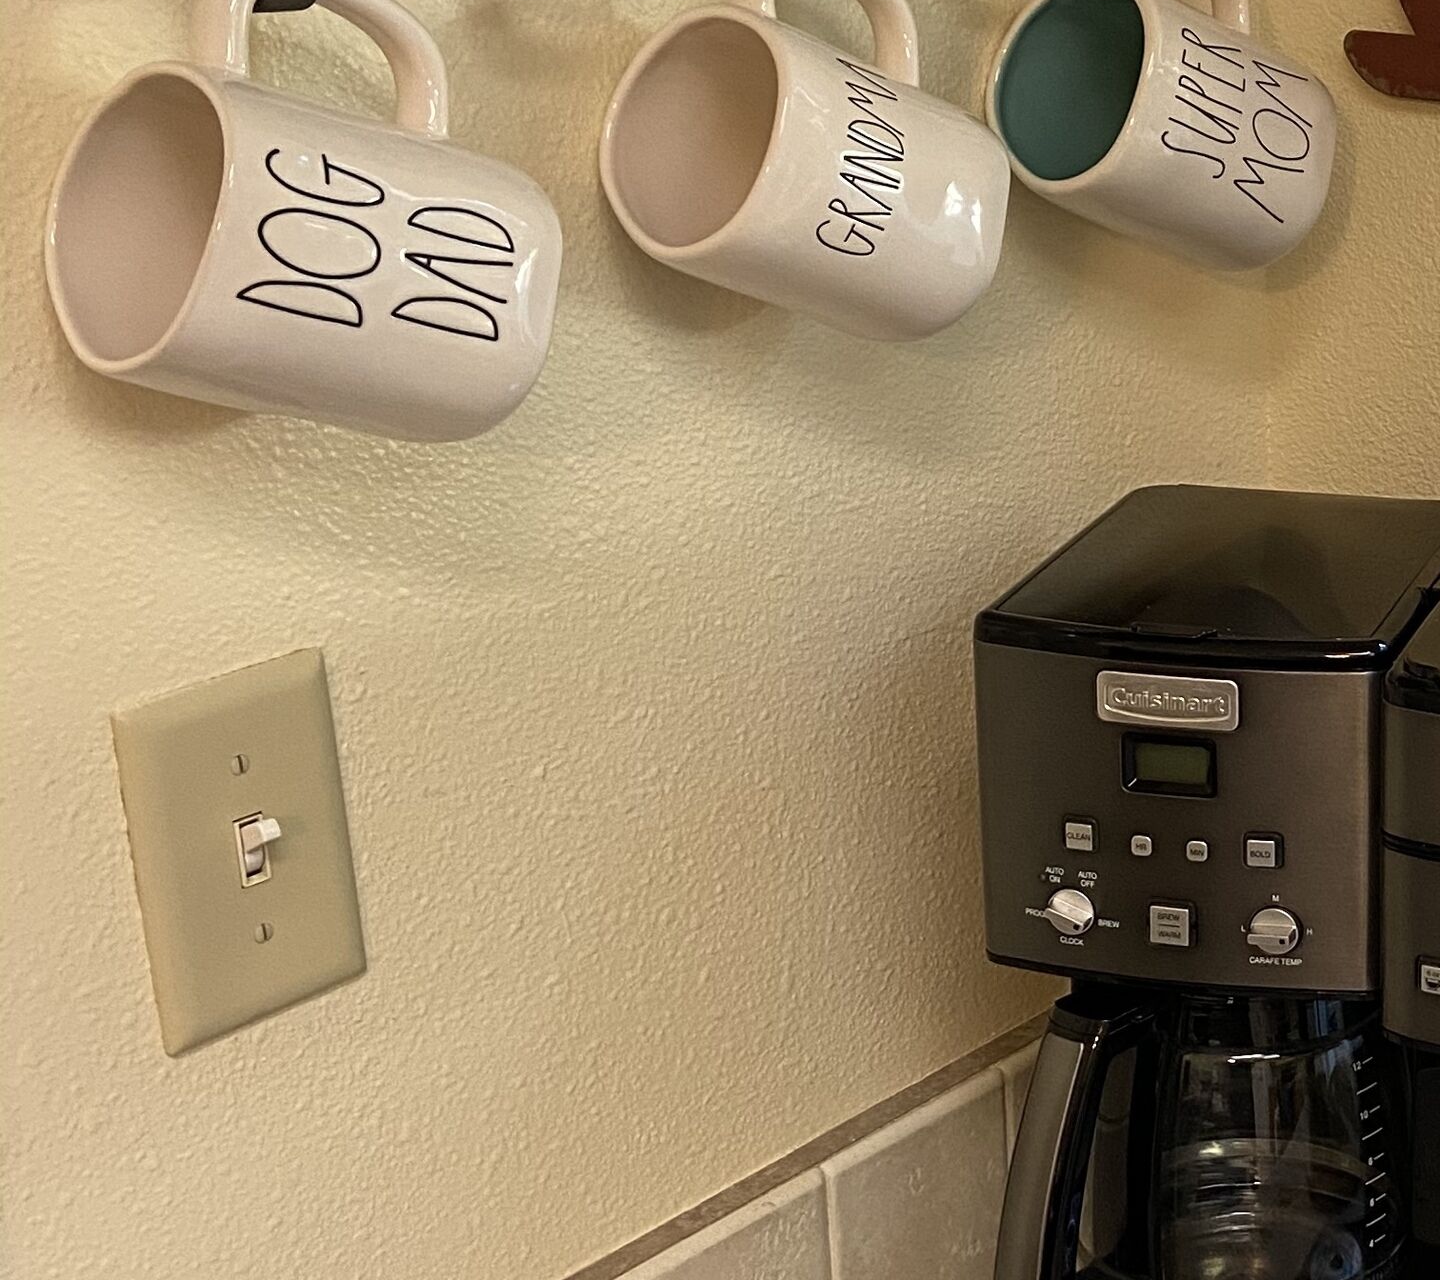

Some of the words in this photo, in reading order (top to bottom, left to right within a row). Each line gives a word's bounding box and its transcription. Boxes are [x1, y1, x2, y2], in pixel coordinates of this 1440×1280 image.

[1162, 27, 1246, 179] SUPER
[1234, 60, 1314, 223] MOM
[816, 57, 905, 256] GRANDMA
[236, 148, 384, 327] DOG
[391, 206, 514, 341] DAD
[1111, 687, 1226, 714] Cuisinart
[1067, 832, 1091, 842] CLEAN
[1135, 843, 1147, 852] HR
[1250, 850, 1271, 858] BOLD
[1045, 866, 1065, 876] AUTO
[1078, 871, 1098, 880] AUTO
[1048, 875, 1061, 883] ON
[1080, 880, 1095, 888] OFF
[1157, 912, 1180, 921] BREW
[1098, 918, 1120, 928] BREW
[1158, 930, 1181, 939] WARM
[1059, 935, 1085, 946] CLOCK
[1249, 956, 1280, 965] CARAFE
[1281, 957, 1303, 966] TEMP
[1352, 1060, 1362, 1072] 12
[1359, 1109, 1370, 1121] 10
